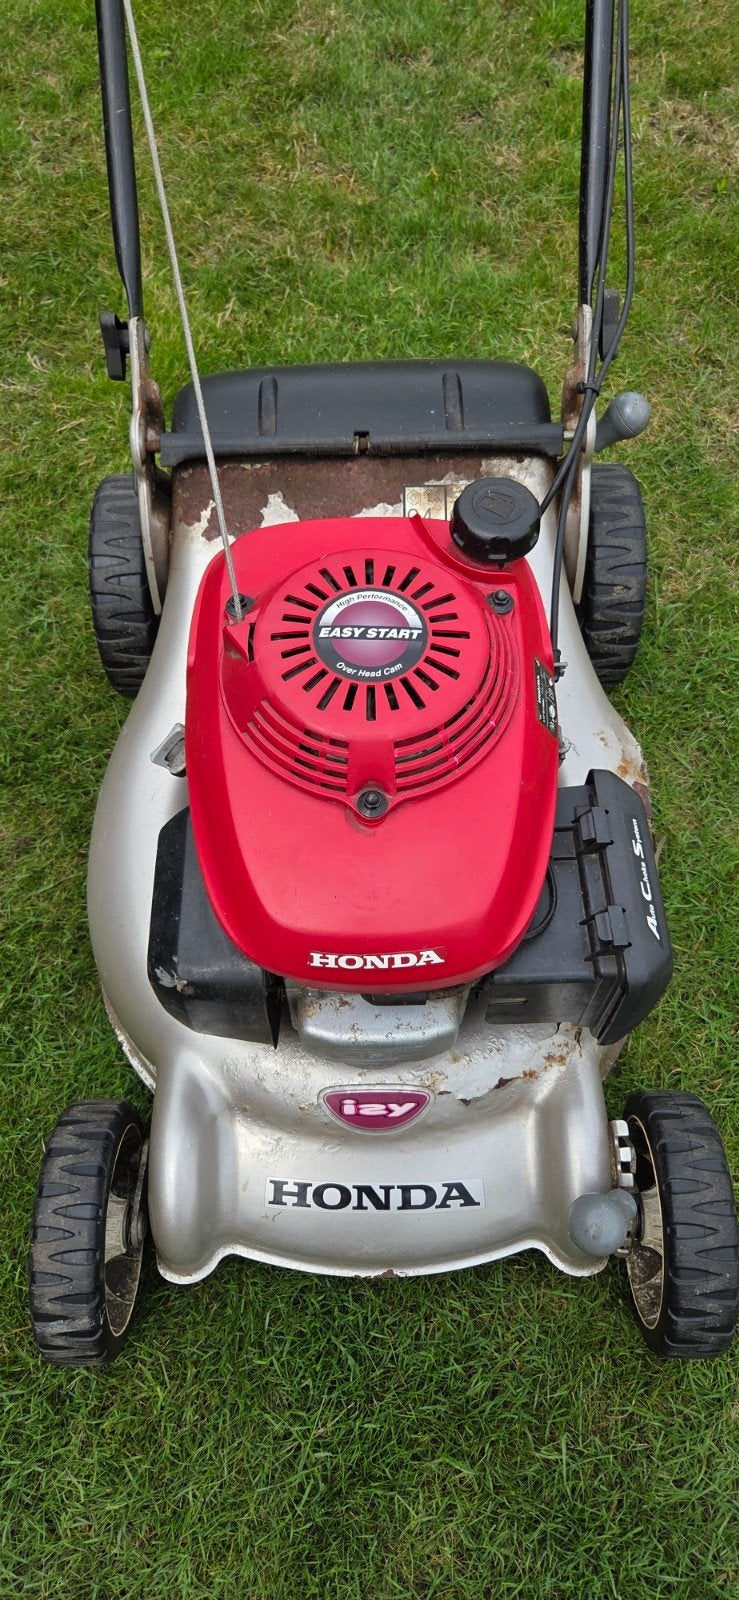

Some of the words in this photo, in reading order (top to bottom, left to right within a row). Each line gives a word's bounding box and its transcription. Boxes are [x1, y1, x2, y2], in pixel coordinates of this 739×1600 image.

[336, 596, 355, 609] High
[357, 594, 408, 612] Performance
[319, 627, 365, 638] EASY
[366, 628, 422, 639] START
[336, 662, 358, 676] Over
[384, 663, 403, 676] Cam
[632, 818, 645, 859] System
[646, 904, 660, 940] Auto
[310, 950, 445, 969] HONDA
[340, 1099, 418, 1118] izy
[268, 1179, 480, 1211] HONDA
